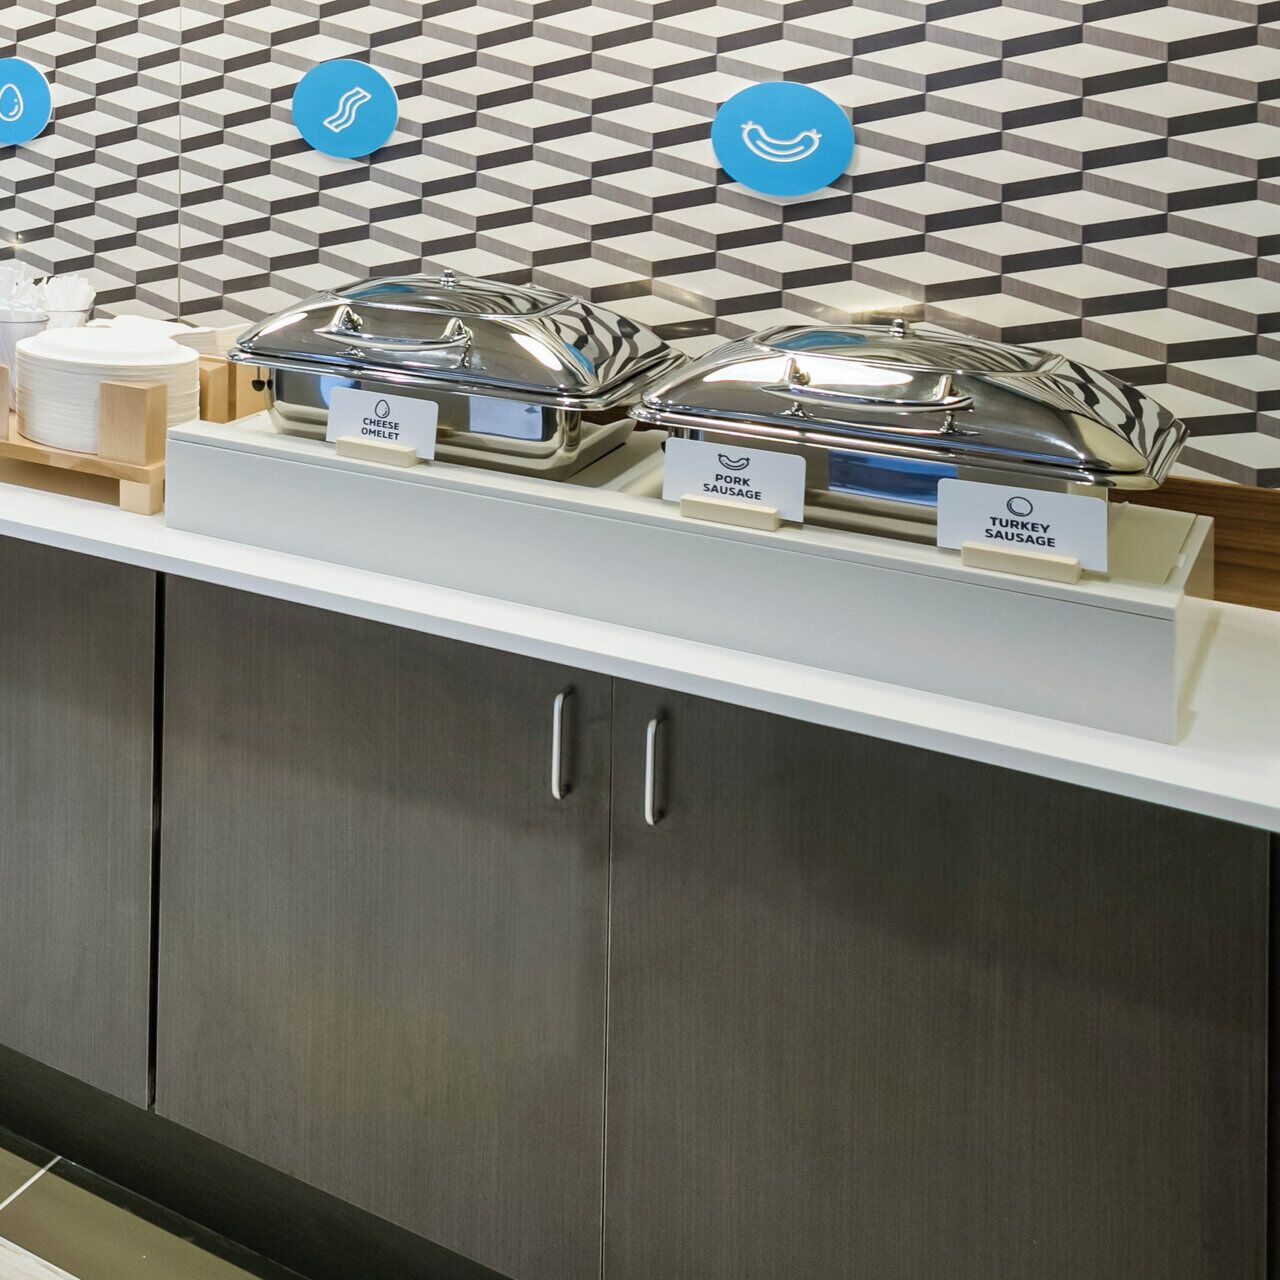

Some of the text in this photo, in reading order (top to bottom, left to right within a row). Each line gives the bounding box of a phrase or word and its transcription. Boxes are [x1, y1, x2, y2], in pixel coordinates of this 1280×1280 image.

[363, 417, 400, 431] CHEESE
[361, 427, 400, 441] OMELET
[715, 473, 751, 487] PORK
[703, 483, 762, 500] SAUSAGE
[990, 516, 1050, 534] TURKEY
[985, 528, 1056, 548] SAUSAGE
